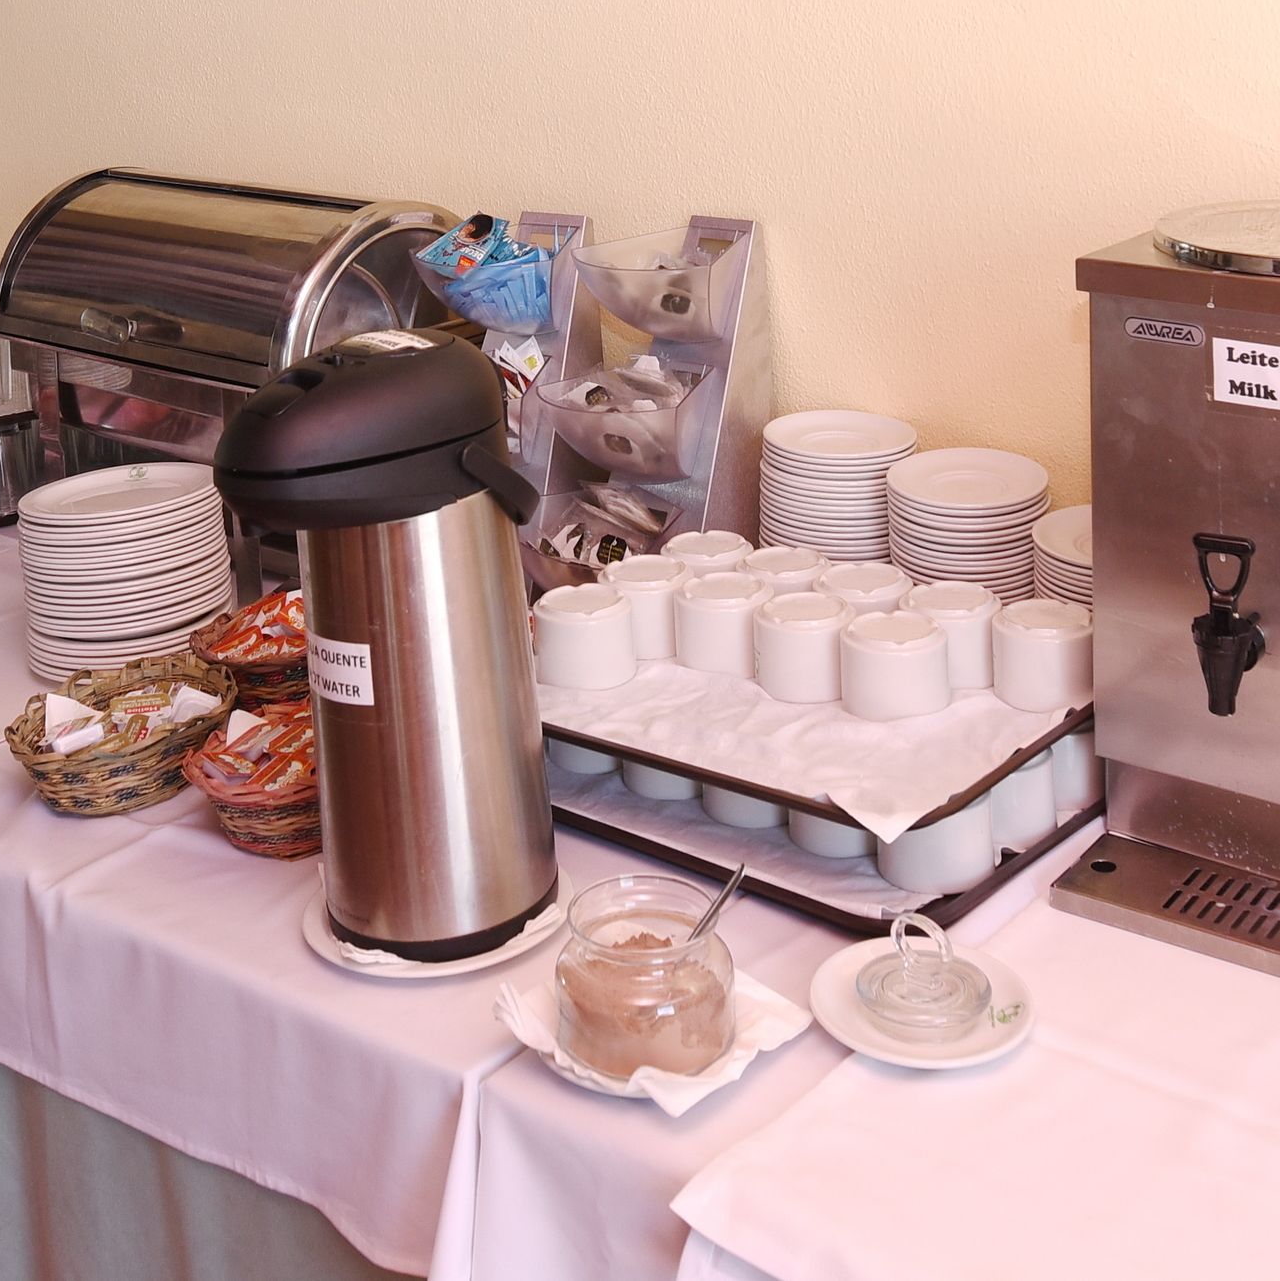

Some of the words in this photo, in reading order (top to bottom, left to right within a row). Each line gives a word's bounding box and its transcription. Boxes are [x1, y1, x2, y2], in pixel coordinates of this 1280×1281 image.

[1226, 346, 1279, 368] Leite
[1228, 379, 1278, 400] Milk
[320, 648, 367, 669] QUENTE
[321, 676, 361, 698] WATER
